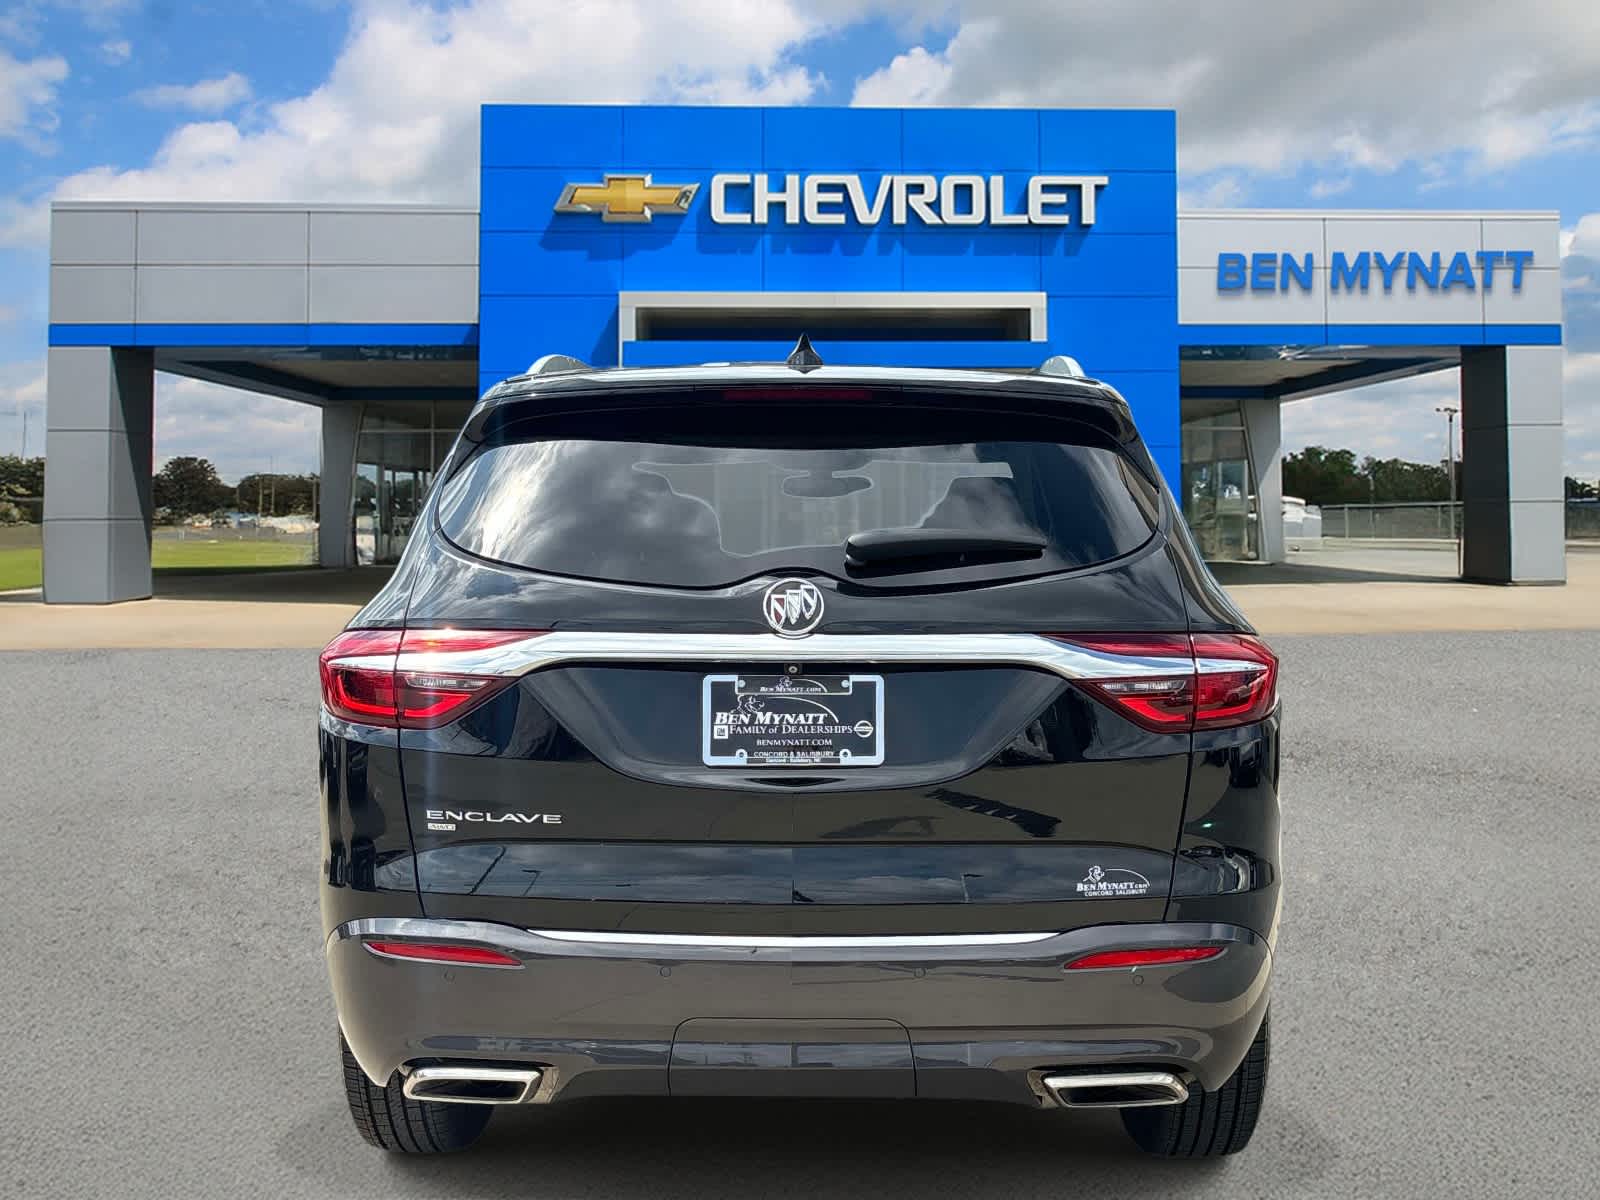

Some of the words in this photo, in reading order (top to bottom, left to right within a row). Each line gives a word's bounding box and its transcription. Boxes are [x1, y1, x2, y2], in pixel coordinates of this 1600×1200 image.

[710, 173, 1110, 225] CHEVROLET
[1217, 252, 1314, 291] BEN
[1330, 250, 1534, 290] MYNATT
[714, 711, 752, 725] BEN
[754, 711, 828, 725] MYNATT
[729, 724, 768, 735] FAMILY
[768, 726, 780, 734] of
[781, 724, 853, 735] DEALERSHIPS
[426, 809, 562, 824] ENCLAVE
[1076, 882, 1097, 892] BEN
